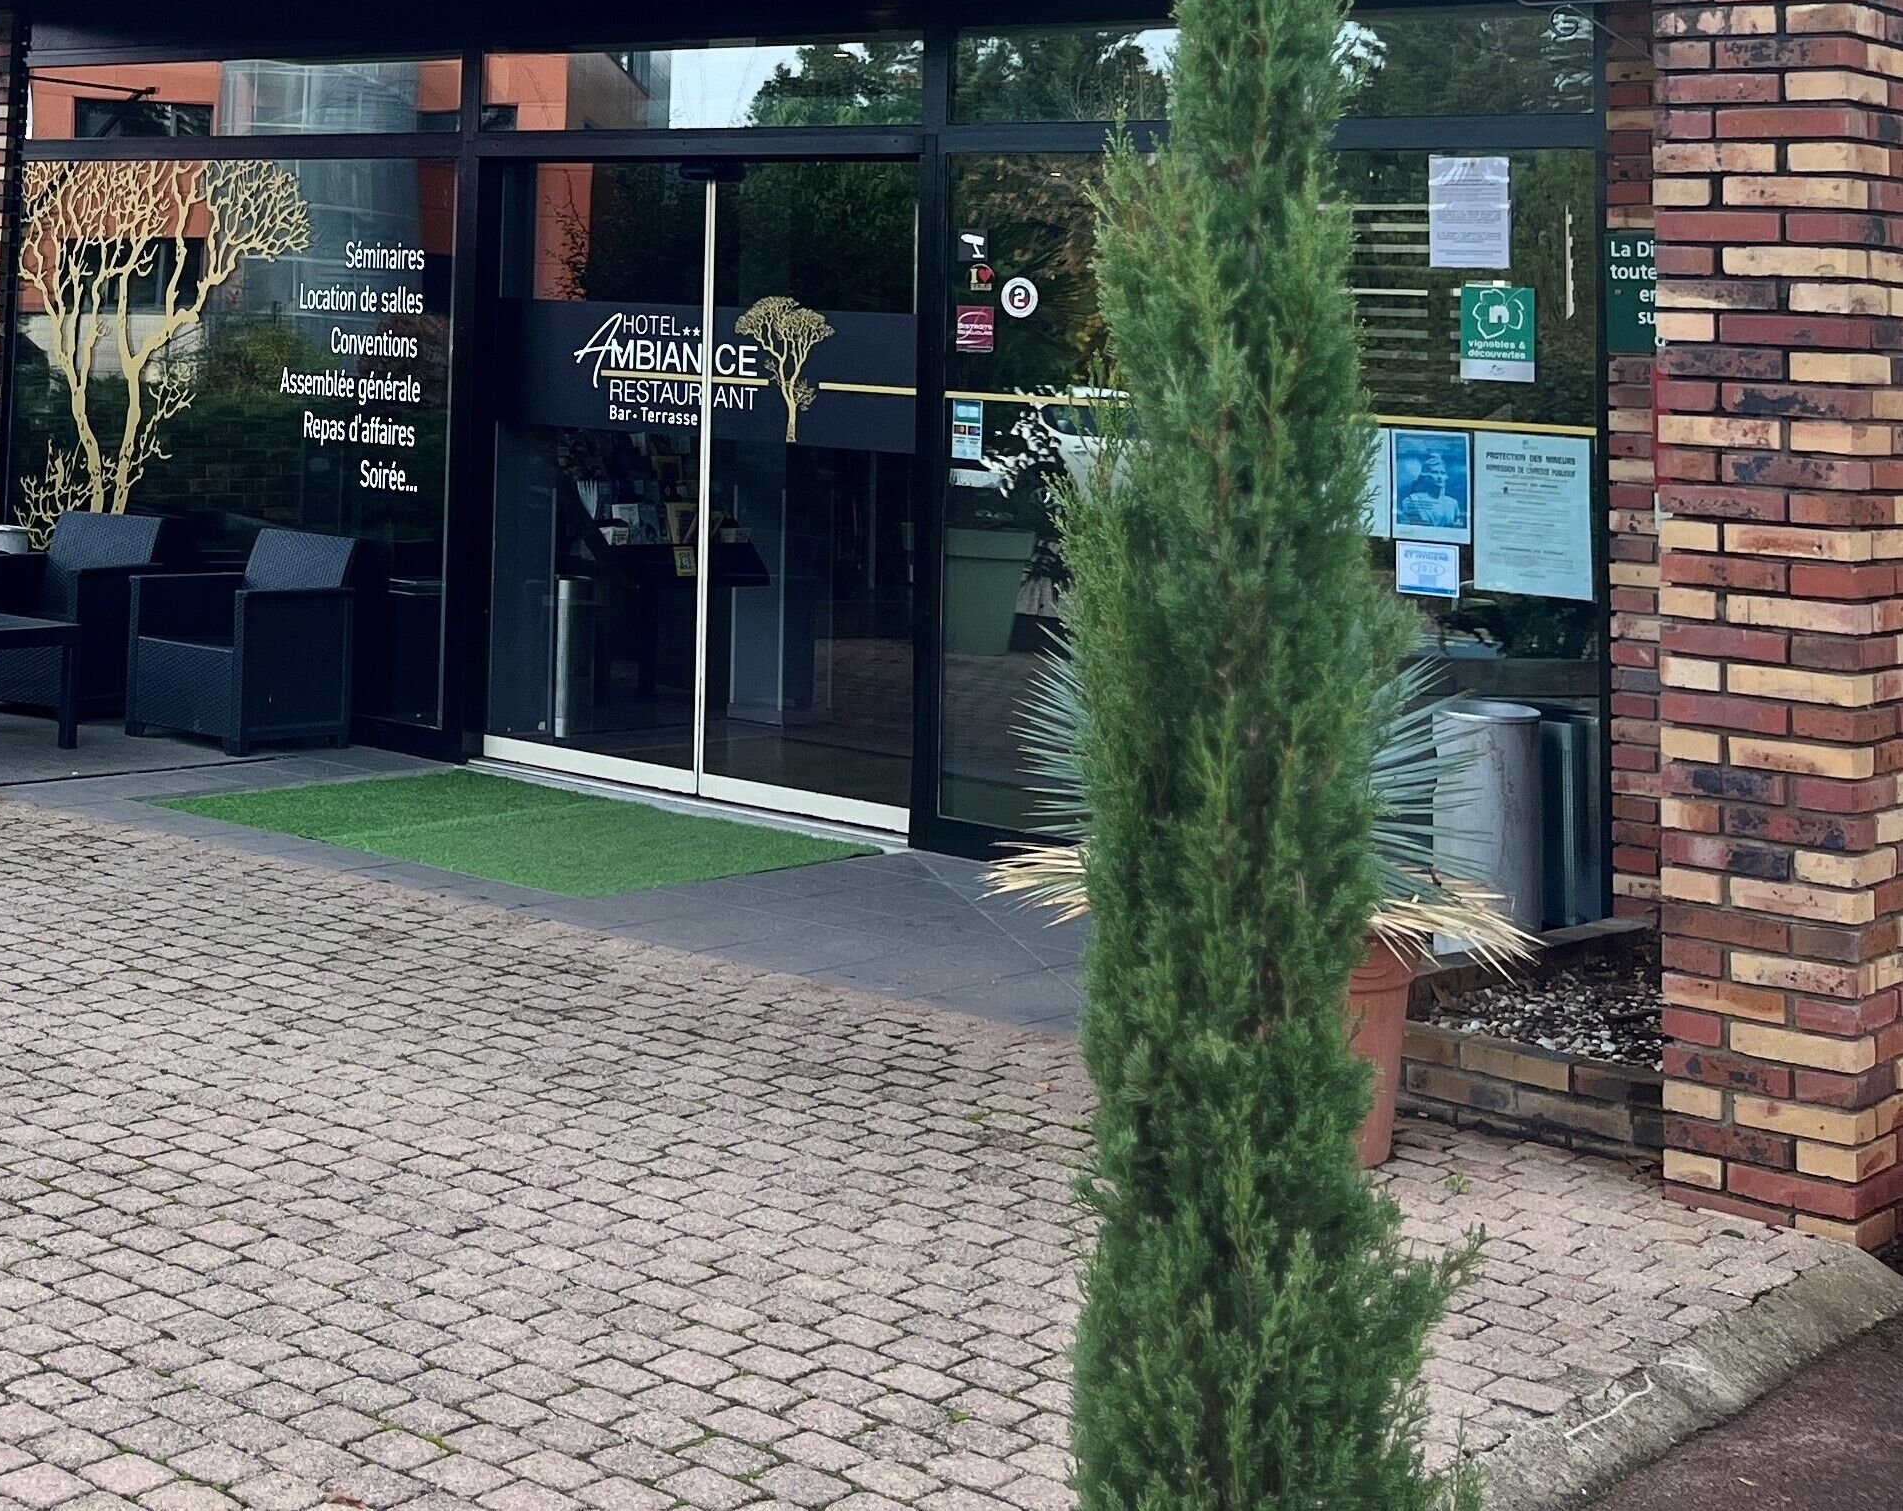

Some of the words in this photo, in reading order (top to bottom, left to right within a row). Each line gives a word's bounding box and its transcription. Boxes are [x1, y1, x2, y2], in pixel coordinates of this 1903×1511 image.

[345, 240, 425, 271] Séminaires
[1610, 241, 1631, 258] La
[1609, 264, 1658, 280] toute
[299, 282, 356, 312] Location
[359, 284, 378, 313] de
[380, 285, 424, 315] salles
[1012, 287, 1026, 308] 2
[622, 314, 681, 337] HOTEL
[330, 326, 418, 359] Conventions
[573, 312, 759, 389] AMBIANCE
[279, 366, 355, 398] Assemblée
[358, 370, 421, 406] générale
[303, 410, 346, 447] Repas
[348, 413, 416, 448] d'affaires
[609, 404, 632, 421] Bar
[640, 406, 699, 426] Terrasse
[1485, 451, 1526, 462] PROTECTION
[359, 459, 418, 493] Soirée...
